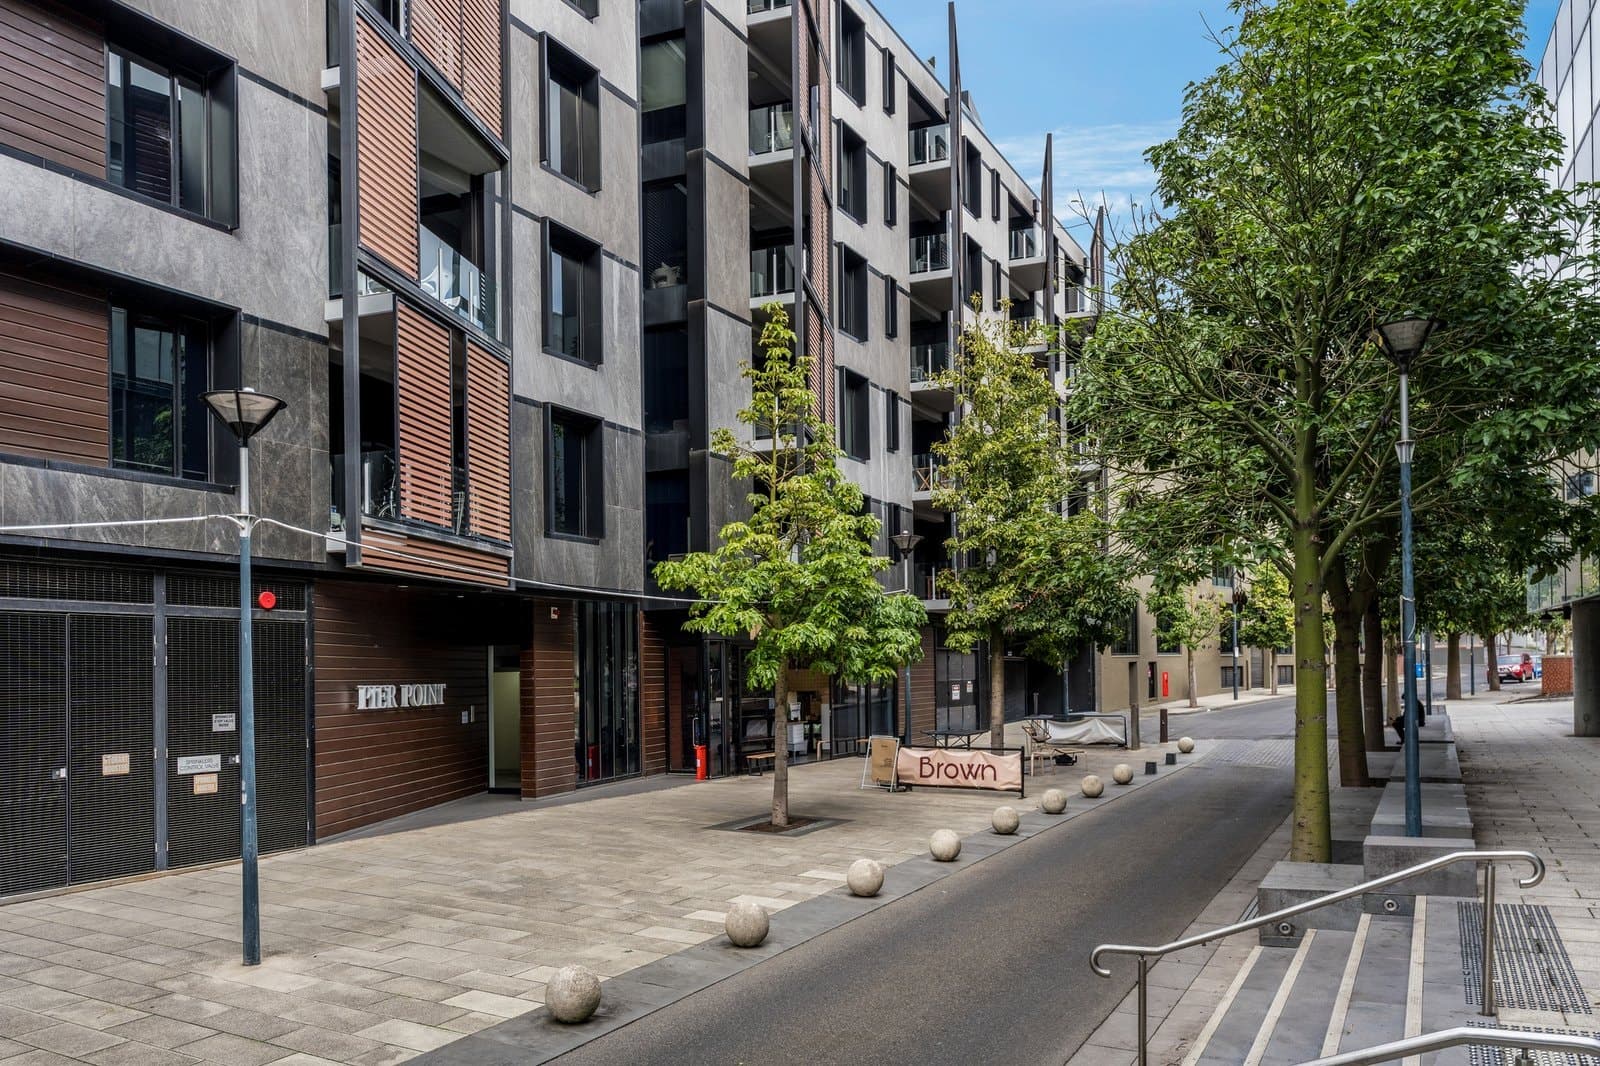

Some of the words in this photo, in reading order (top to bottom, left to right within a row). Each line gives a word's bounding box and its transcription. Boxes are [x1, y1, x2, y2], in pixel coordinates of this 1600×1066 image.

[357, 684, 398, 710] PIER
[400, 683, 446, 707] POINT
[919, 756, 997, 782] Brown
